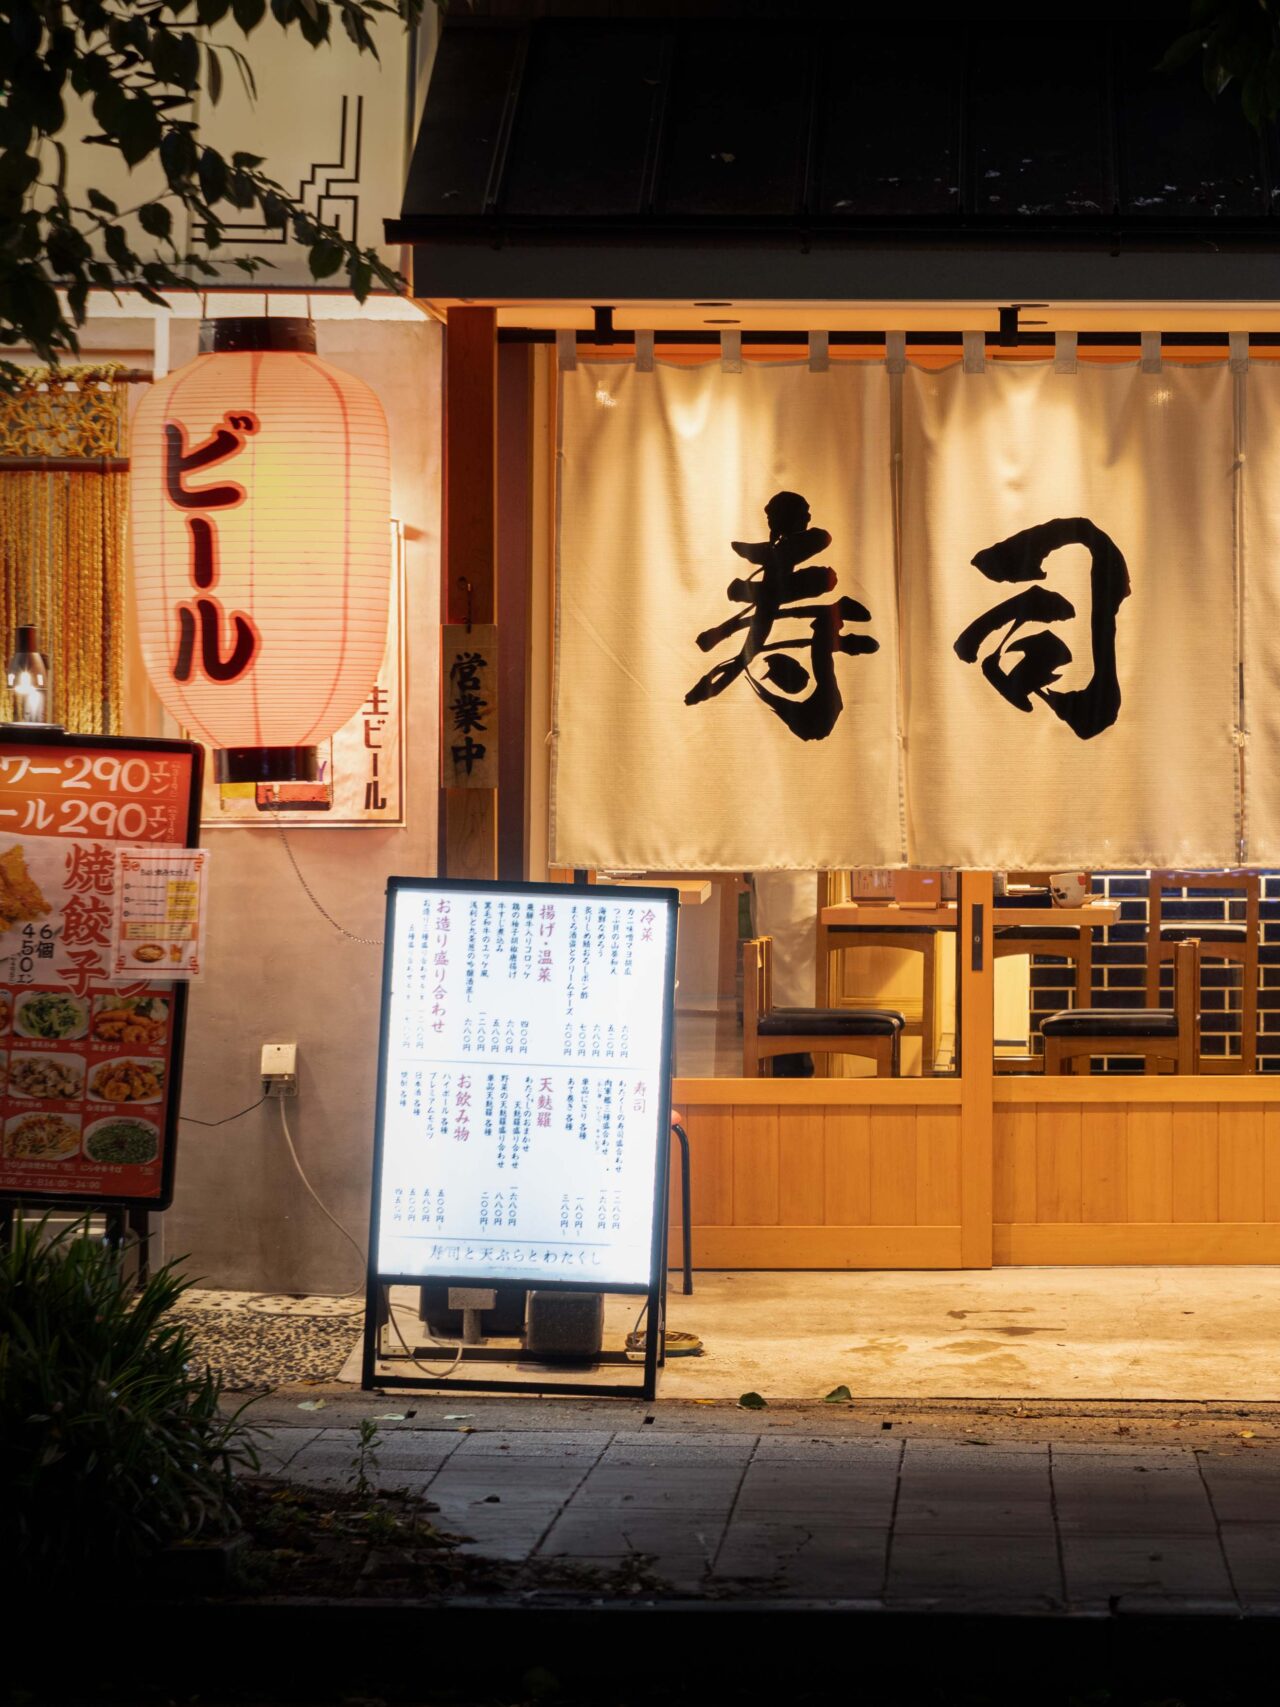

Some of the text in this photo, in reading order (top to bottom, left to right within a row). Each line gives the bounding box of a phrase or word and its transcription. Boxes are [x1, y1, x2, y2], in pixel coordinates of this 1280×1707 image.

[165, 408, 258, 684] ビール
[685, 490, 1132, 742] 寿司
[449, 652, 488, 777] 営業中
[36, 923, 55, 959] 6個
[56, 843, 115, 999] 焼餃子
[431, 898, 451, 1034] お造り盛り合わせ
[537, 904, 556, 983] 揚げ・温菜
[453, 1073, 473, 1142] お飲み物
[633, 1081, 647, 1114] 寿司
[429, 1244, 601, 1265] 寿司と天ぷらとわたくし
